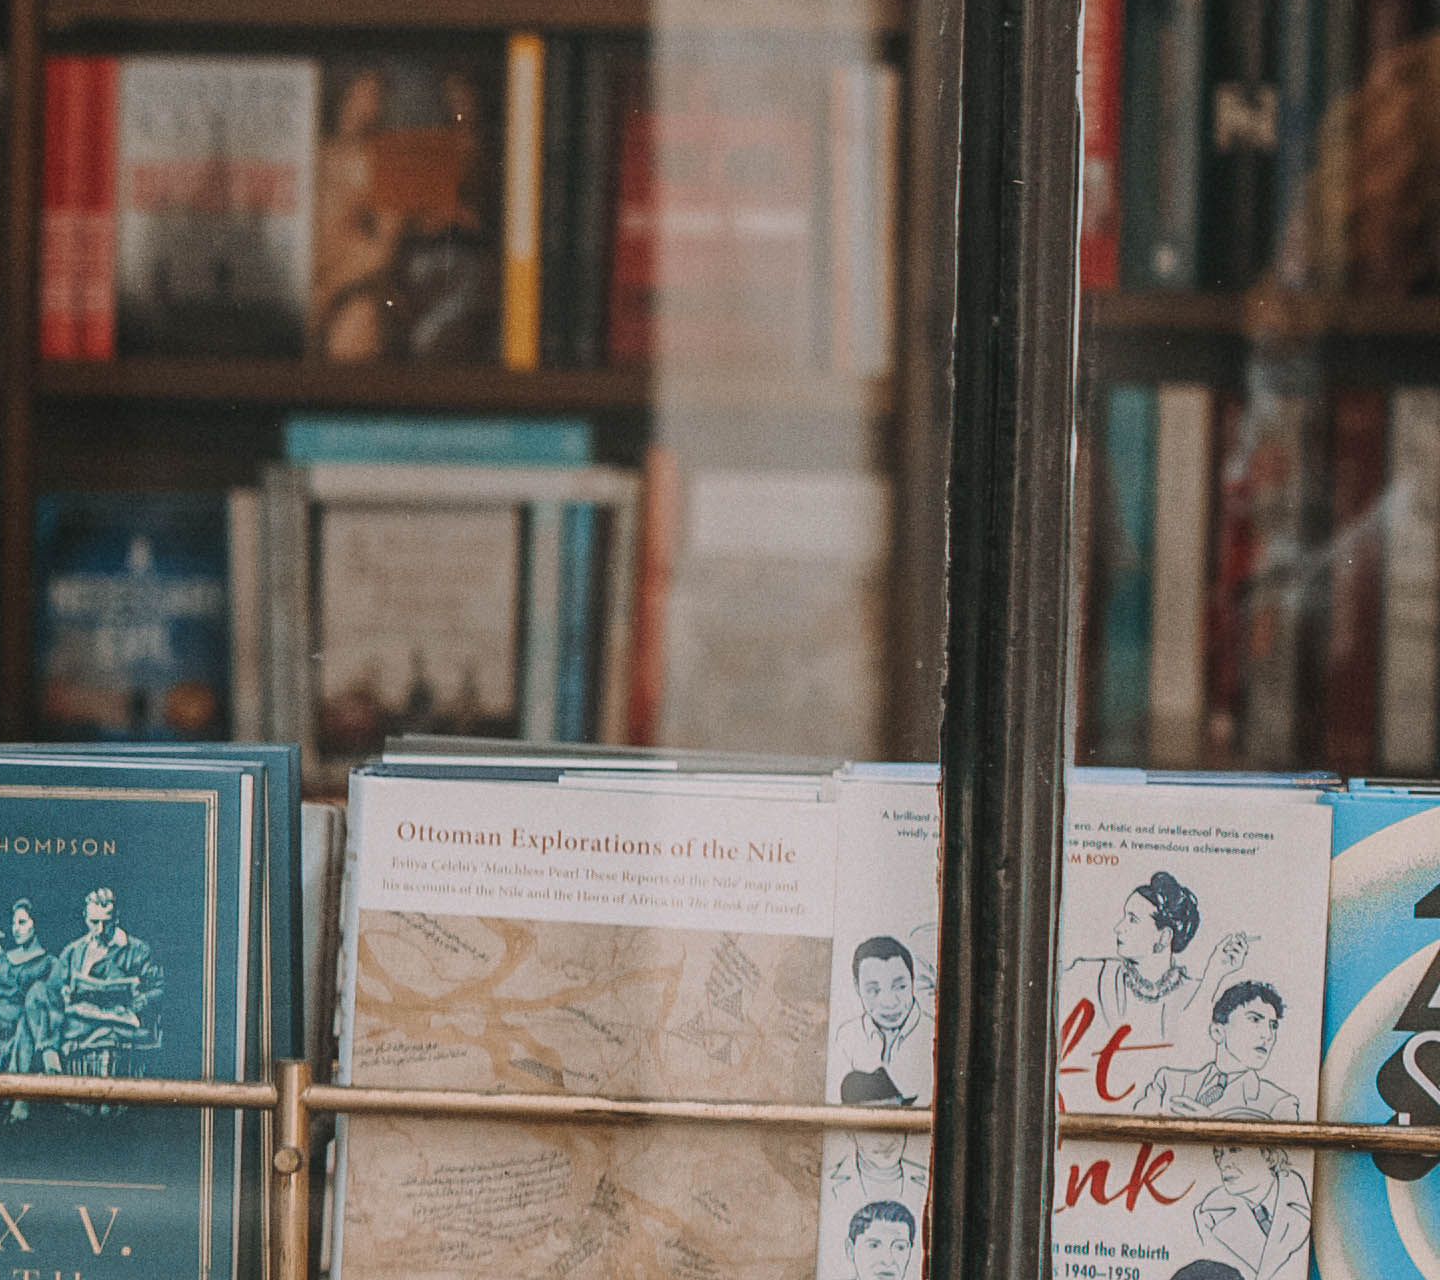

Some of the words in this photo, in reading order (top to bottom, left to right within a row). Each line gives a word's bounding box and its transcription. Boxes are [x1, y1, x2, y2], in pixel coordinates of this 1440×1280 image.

[1098, 822, 1132, 834] Artistic
[1135, 825, 1156, 835] and
[1158, 824, 1213, 838] intellectual
[1215, 827, 1241, 839] Paris
[1243, 830, 1275, 841] comes
[396, 821, 503, 848] Ottoman
[511, 826, 663, 857] Explorations
[670, 837, 696, 858] of
[702, 839, 739, 861] the
[747, 838, 797, 864] Nile
[1120, 838, 1129, 849] A
[1131, 840, 1191, 854] tremendous
[1086, 853, 1121, 867] BOYD
[78, 1204, 133, 1257] V.
[1064, 1241, 1090, 1257] and
[1094, 1241, 1117, 1258] the
[1121, 1242, 1171, 1262] Rebirth
